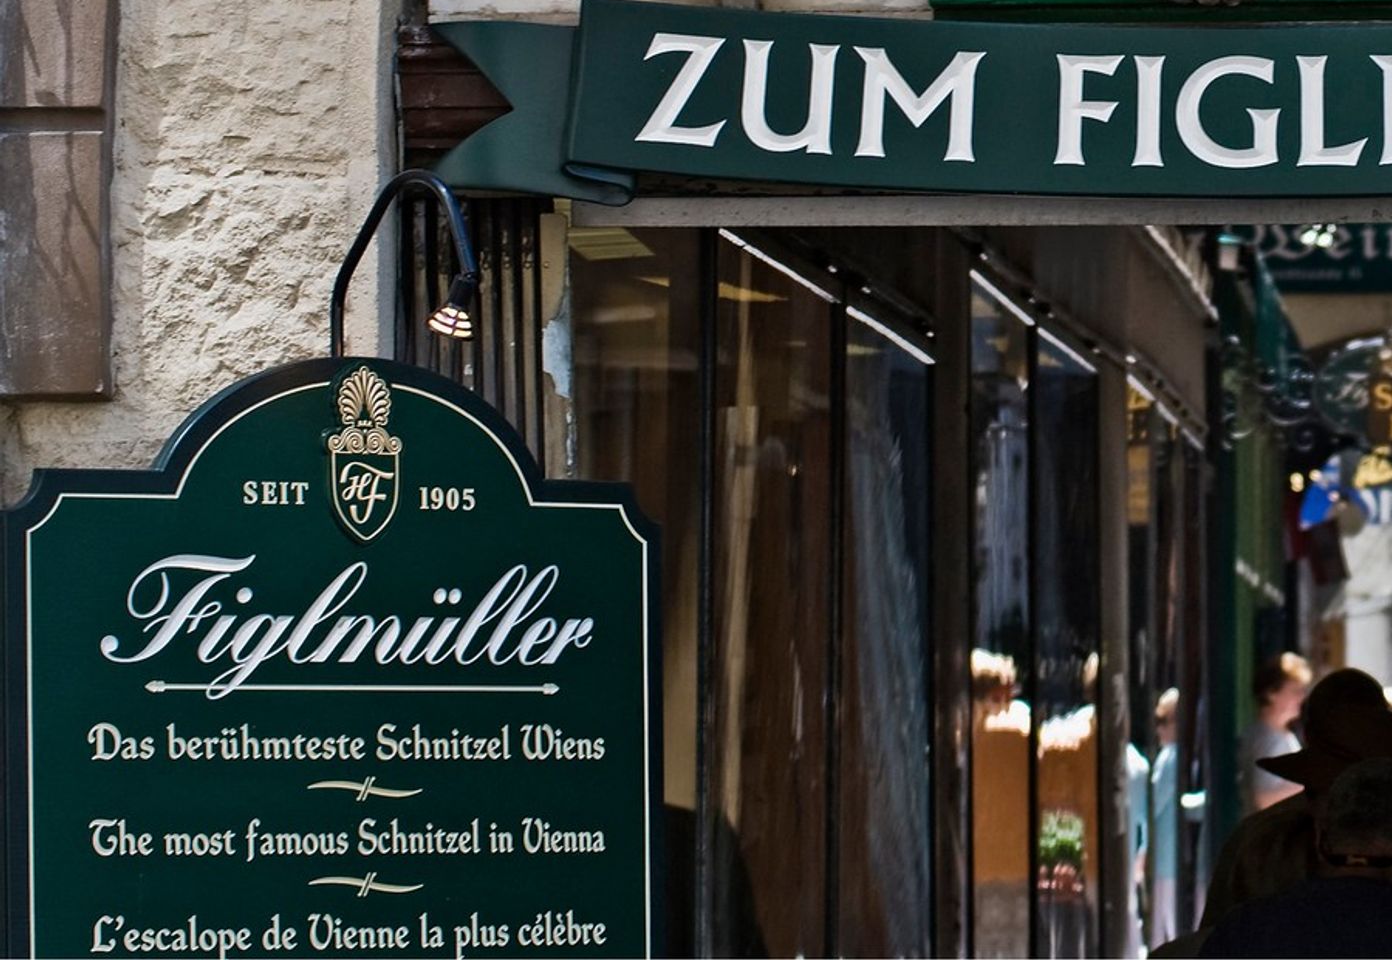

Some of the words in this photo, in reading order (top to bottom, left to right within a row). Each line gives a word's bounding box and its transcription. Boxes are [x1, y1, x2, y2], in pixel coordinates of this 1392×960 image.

[634, 32, 987, 163] ZUM
[243, 480, 309, 505] SEIT
[419, 486, 476, 511] 1905
[100, 554, 594, 700] Figlmüller
[87, 722, 156, 761] Das
[165, 722, 366, 761] berühmteste
[375, 723, 512, 761] Schnitzel
[519, 723, 606, 761] Wiens
[88, 818, 154, 857] The
[163, 829, 237, 856] most
[244, 817, 350, 863] famous
[357, 817, 481, 856] Schnitzel
[488, 822, 515, 854] in
[521, 817, 606, 854] Vienna
[262, 913, 298, 951] de
[307, 913, 410, 951] Vienne
[418, 912, 445, 949] la
[453, 911, 510, 960] plus
[517, 909, 607, 947] célèbre
